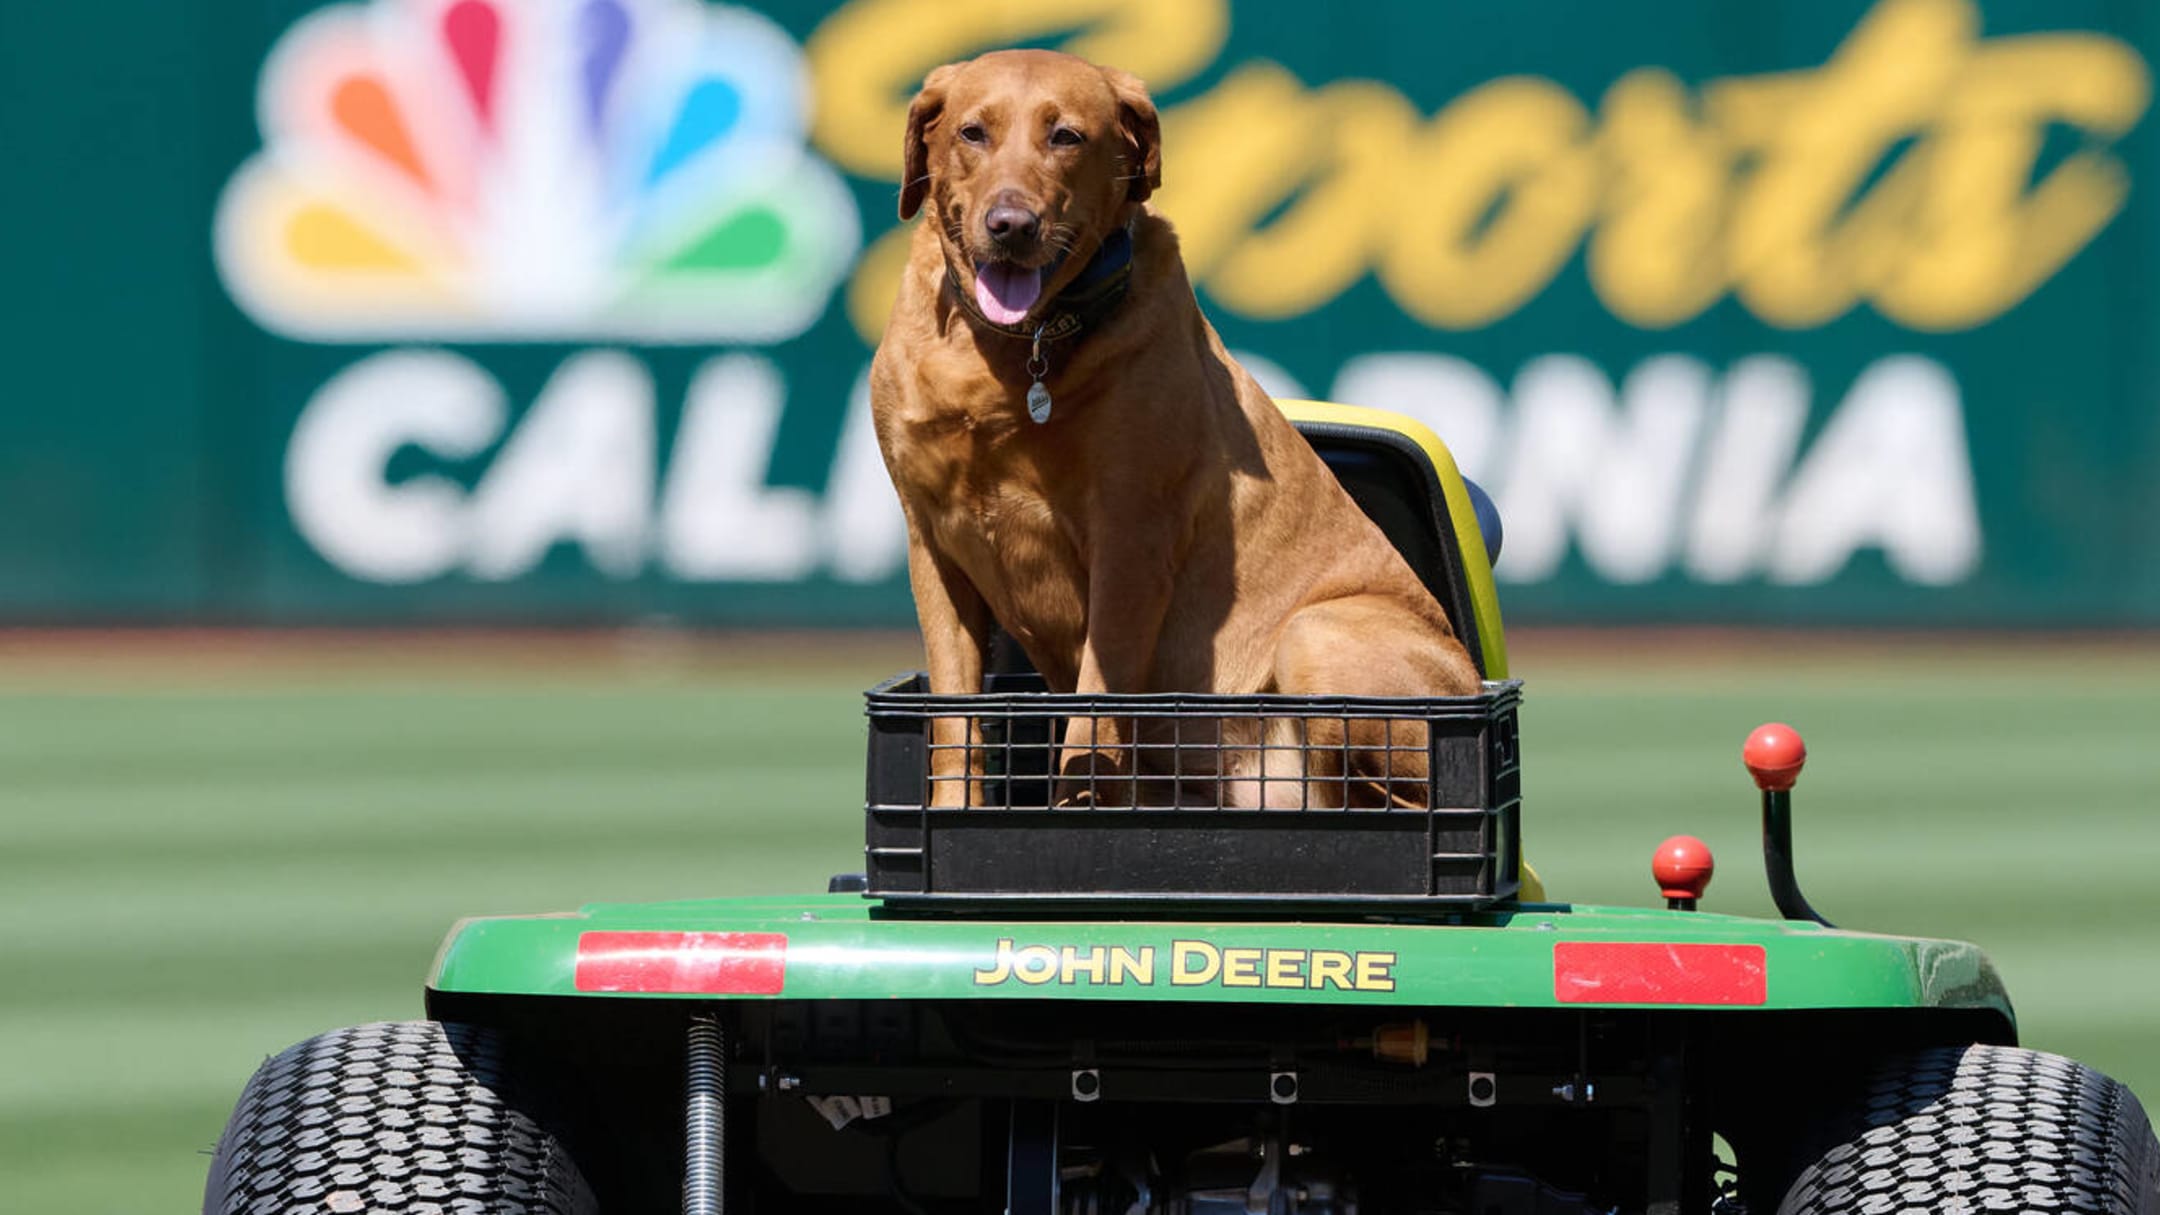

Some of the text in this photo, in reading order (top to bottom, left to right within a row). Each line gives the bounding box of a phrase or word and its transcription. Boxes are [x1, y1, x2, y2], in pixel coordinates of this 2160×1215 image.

[284, 348, 1980, 586] CALINIA
[974, 938, 1397, 992] JOHN DEERE
